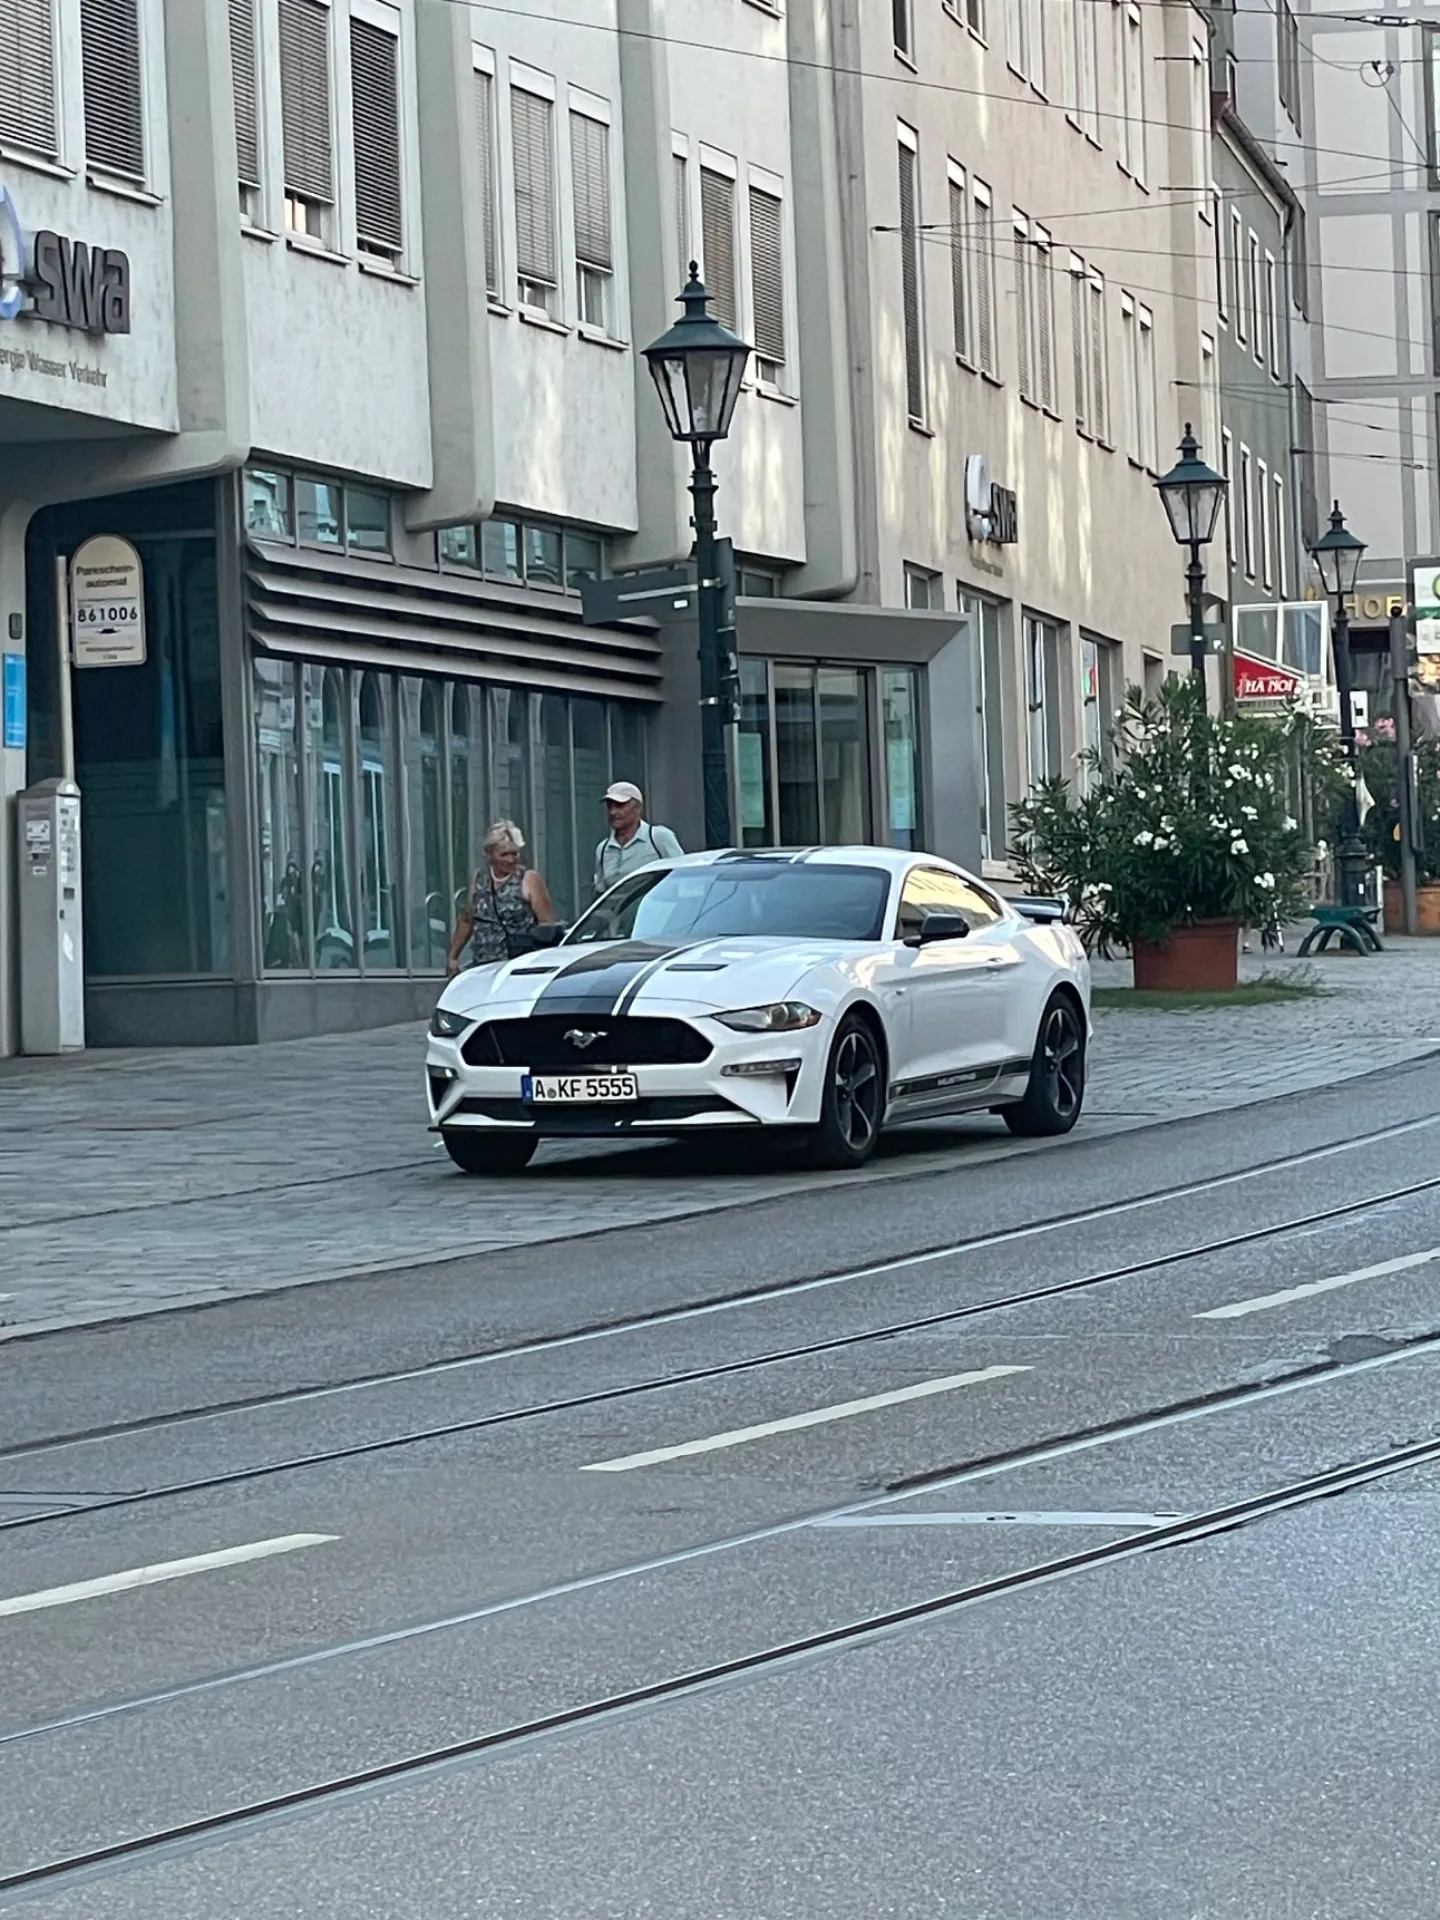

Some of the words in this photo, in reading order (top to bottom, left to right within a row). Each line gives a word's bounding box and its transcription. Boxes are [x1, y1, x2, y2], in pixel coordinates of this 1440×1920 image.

[26, 350, 67, 378] Wasser
[77, 606, 138, 622] 861006
[535, 1080, 545, 1098] A
[558, 1079, 581, 1098] KF
[586, 1077, 634, 1097] 5555
